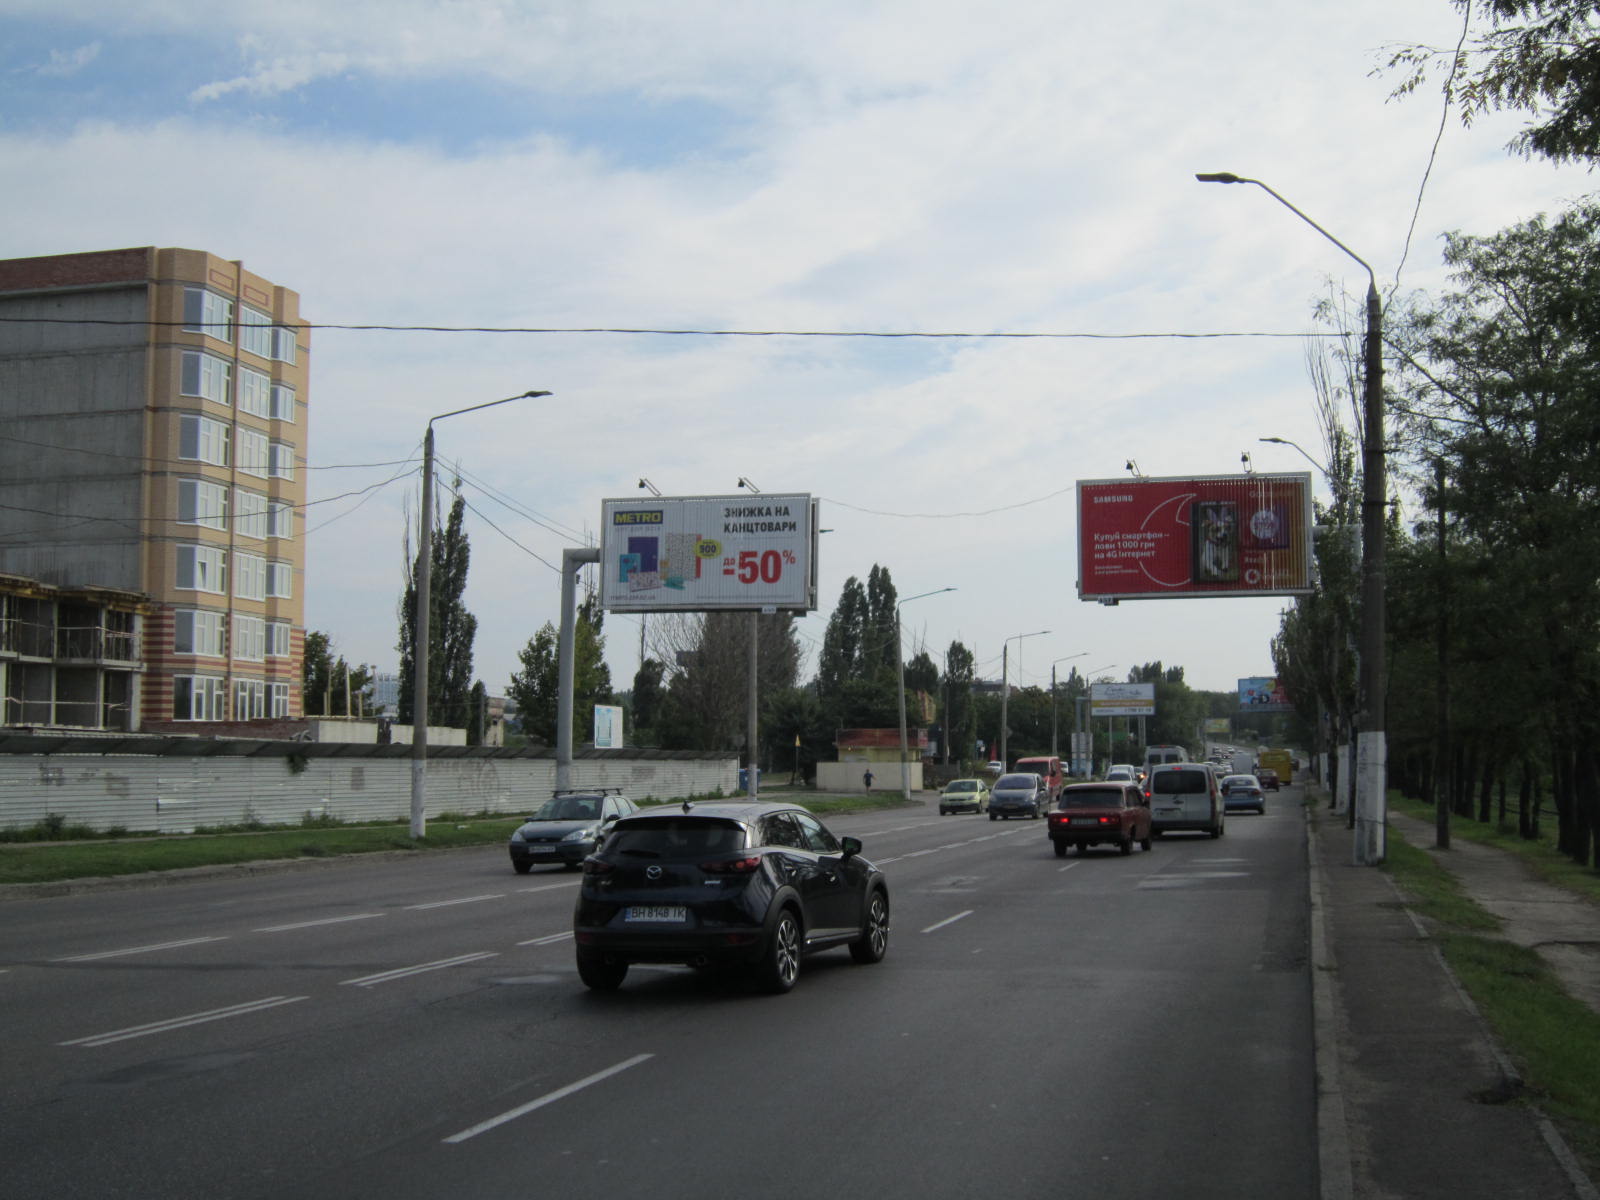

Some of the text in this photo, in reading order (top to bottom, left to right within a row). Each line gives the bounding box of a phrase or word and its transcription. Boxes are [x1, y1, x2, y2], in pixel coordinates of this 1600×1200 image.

[615, 511, 662, 524] METRO
[724, 506, 790, 518] ЗНИЖКА НА
[723, 521, 797, 534] КАНЦТОВАРИ
